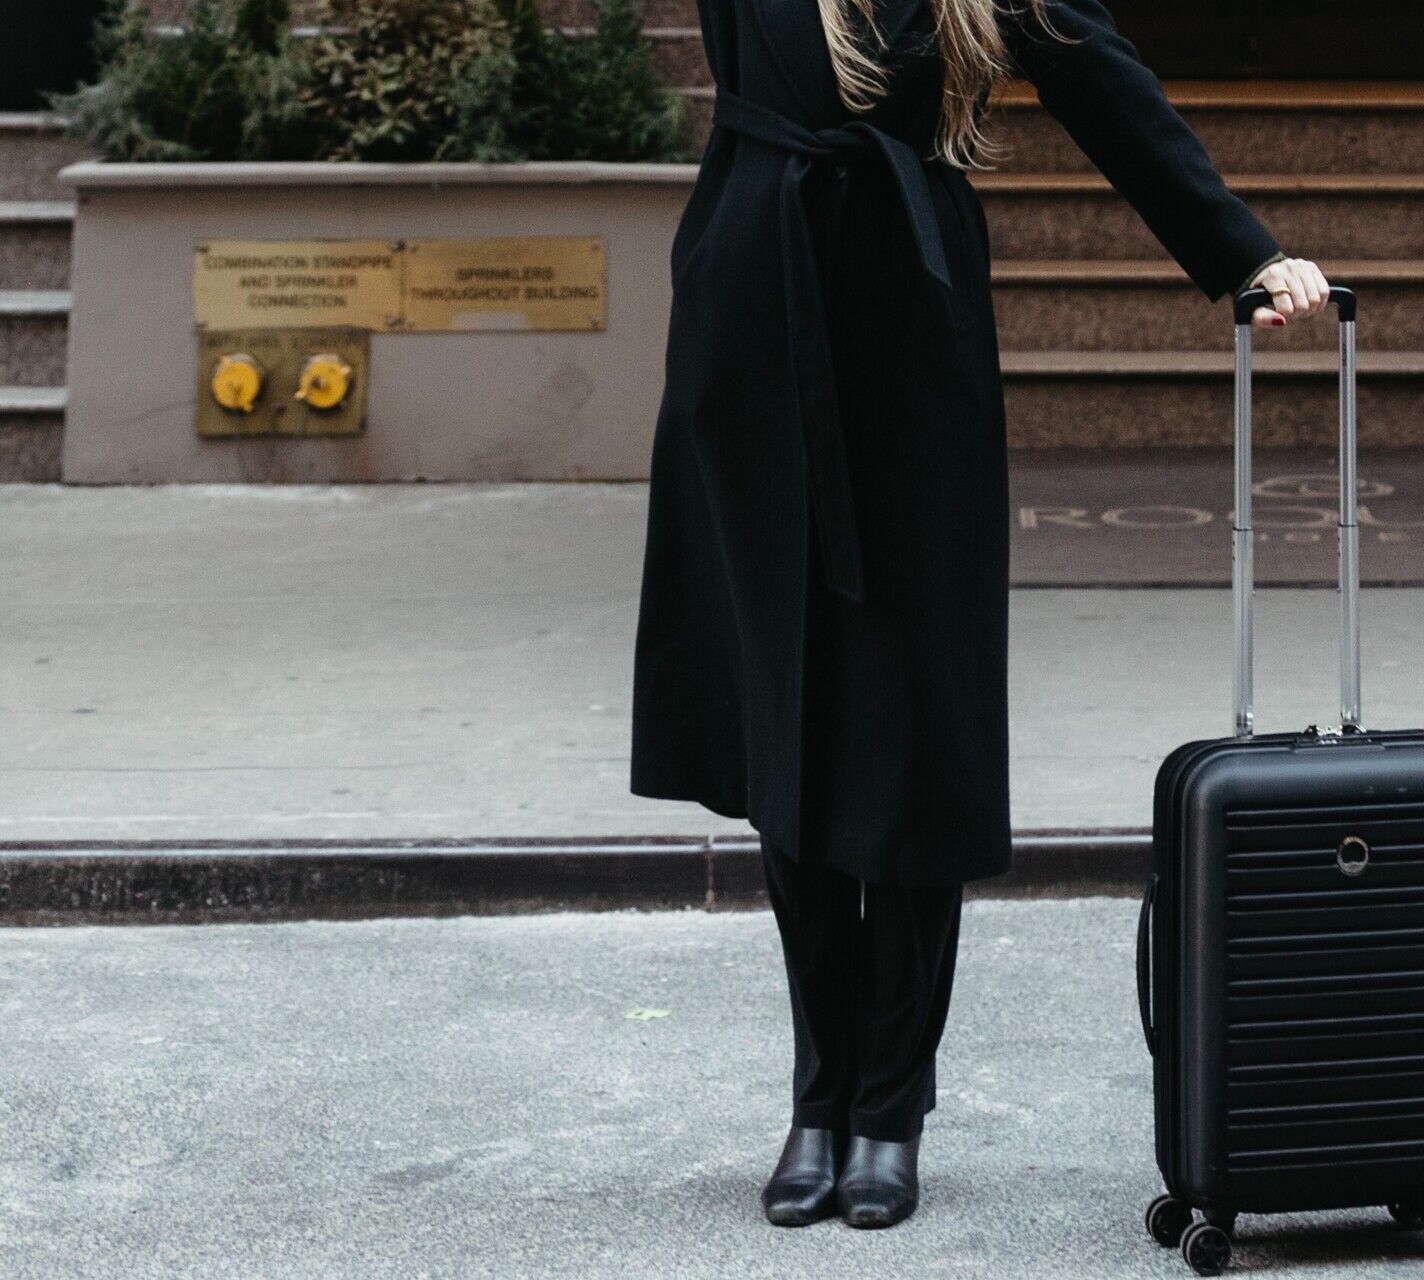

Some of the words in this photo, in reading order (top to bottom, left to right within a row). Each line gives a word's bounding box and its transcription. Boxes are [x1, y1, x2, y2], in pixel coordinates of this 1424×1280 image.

[455, 267, 553, 281] SPRINKLERS
[239, 276, 271, 288] AND
[411, 287, 519, 300] THROUGHOUT
[524, 286, 599, 299] BUILDING
